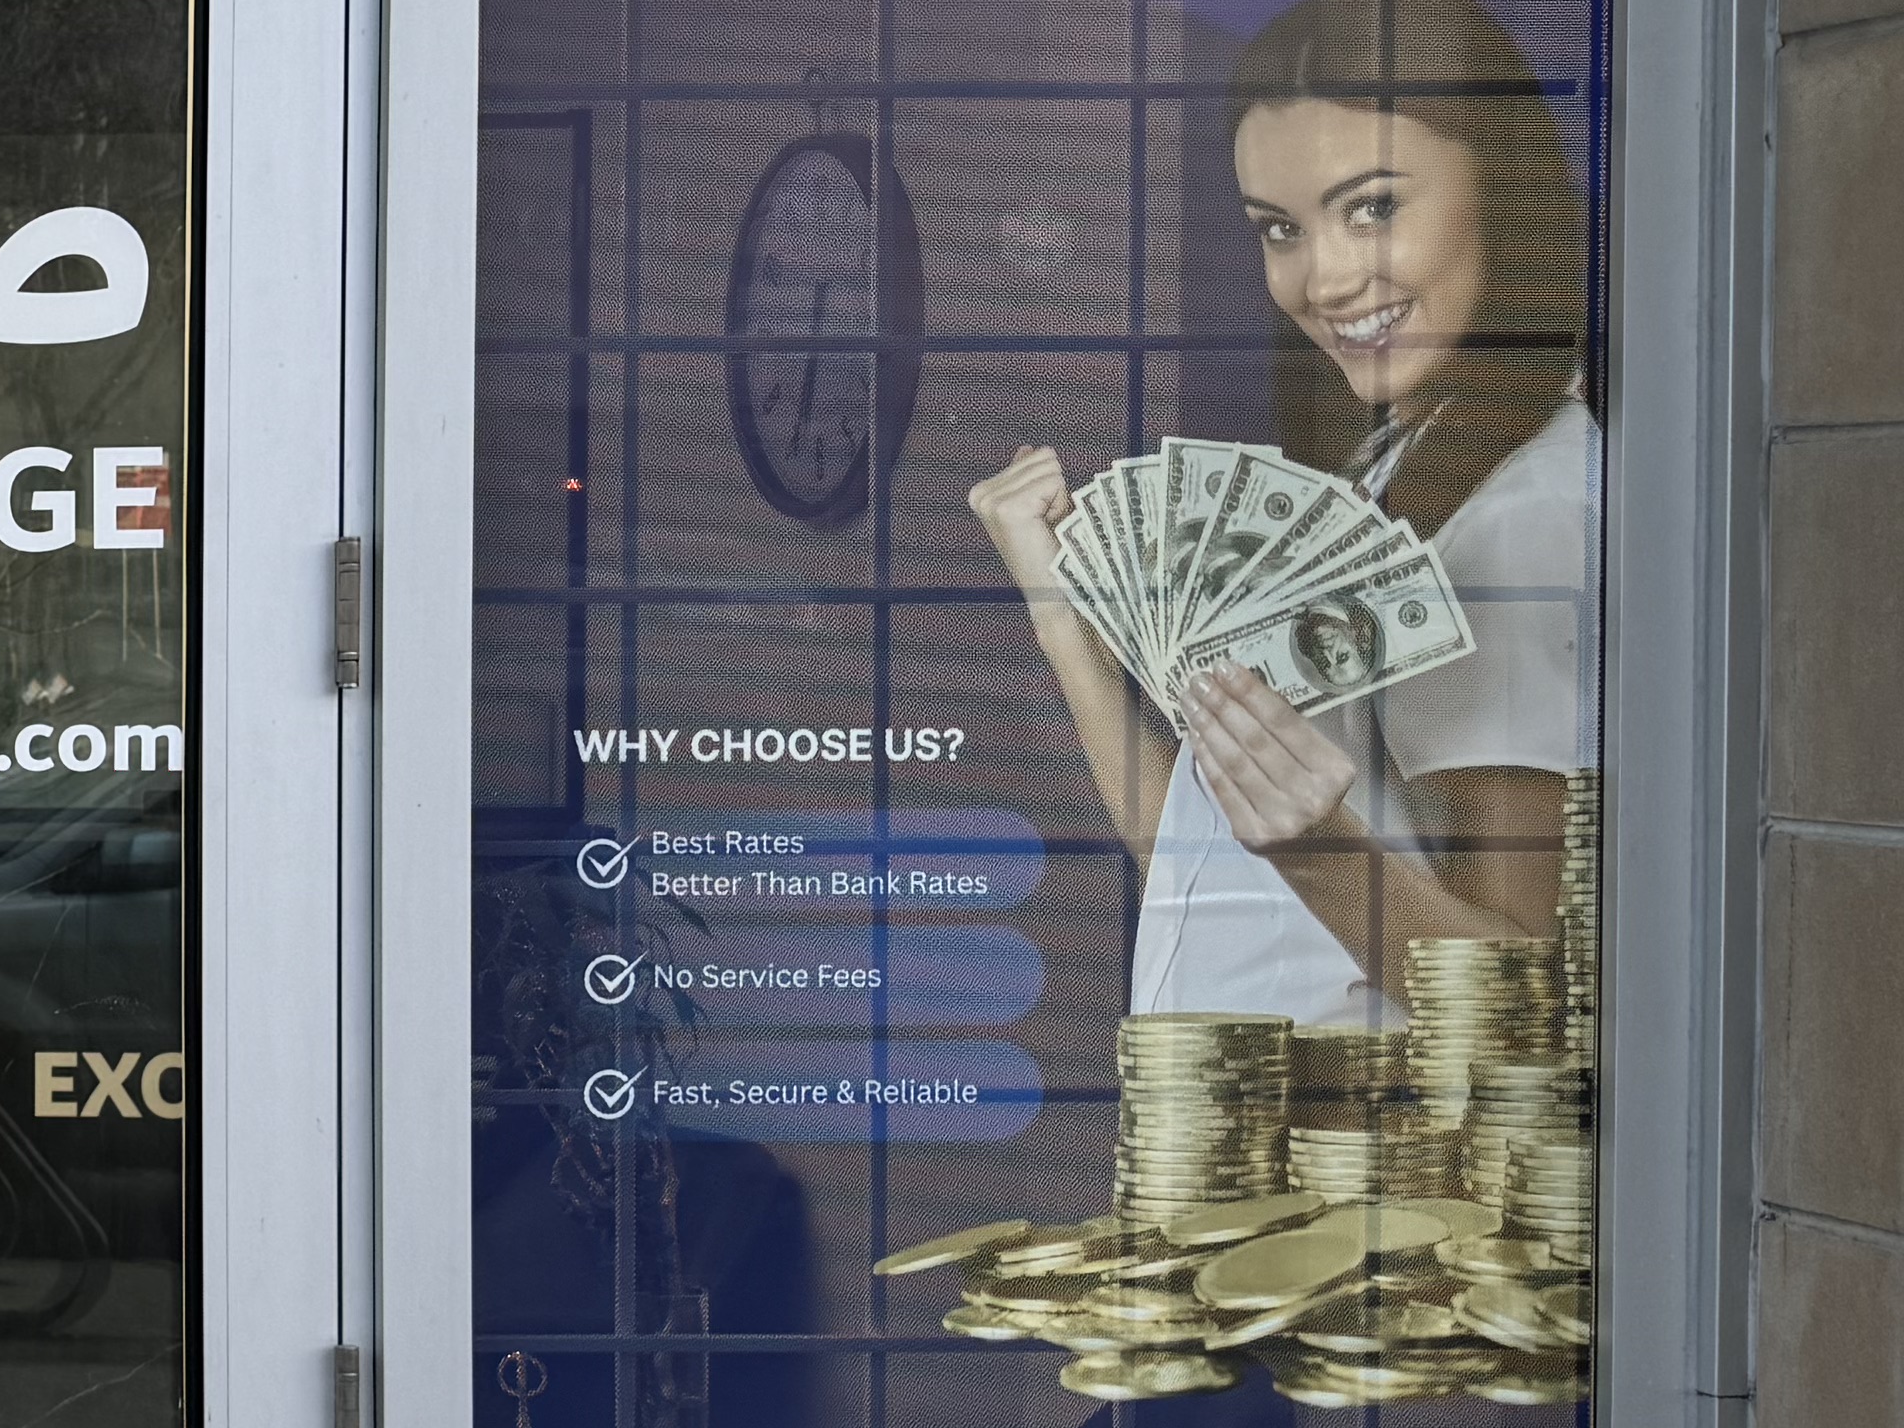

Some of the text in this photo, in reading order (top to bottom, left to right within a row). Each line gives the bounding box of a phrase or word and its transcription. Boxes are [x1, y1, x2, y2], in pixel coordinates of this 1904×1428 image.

[574, 728, 965, 761] WHY CHOOSE US?
[652, 832, 804, 855] Best Rates
[652, 872, 987, 896] Better Than Bank Rates
[654, 964, 881, 988] No Service Fees
[653, 1080, 978, 1109] Fast, Secure & Reliable
